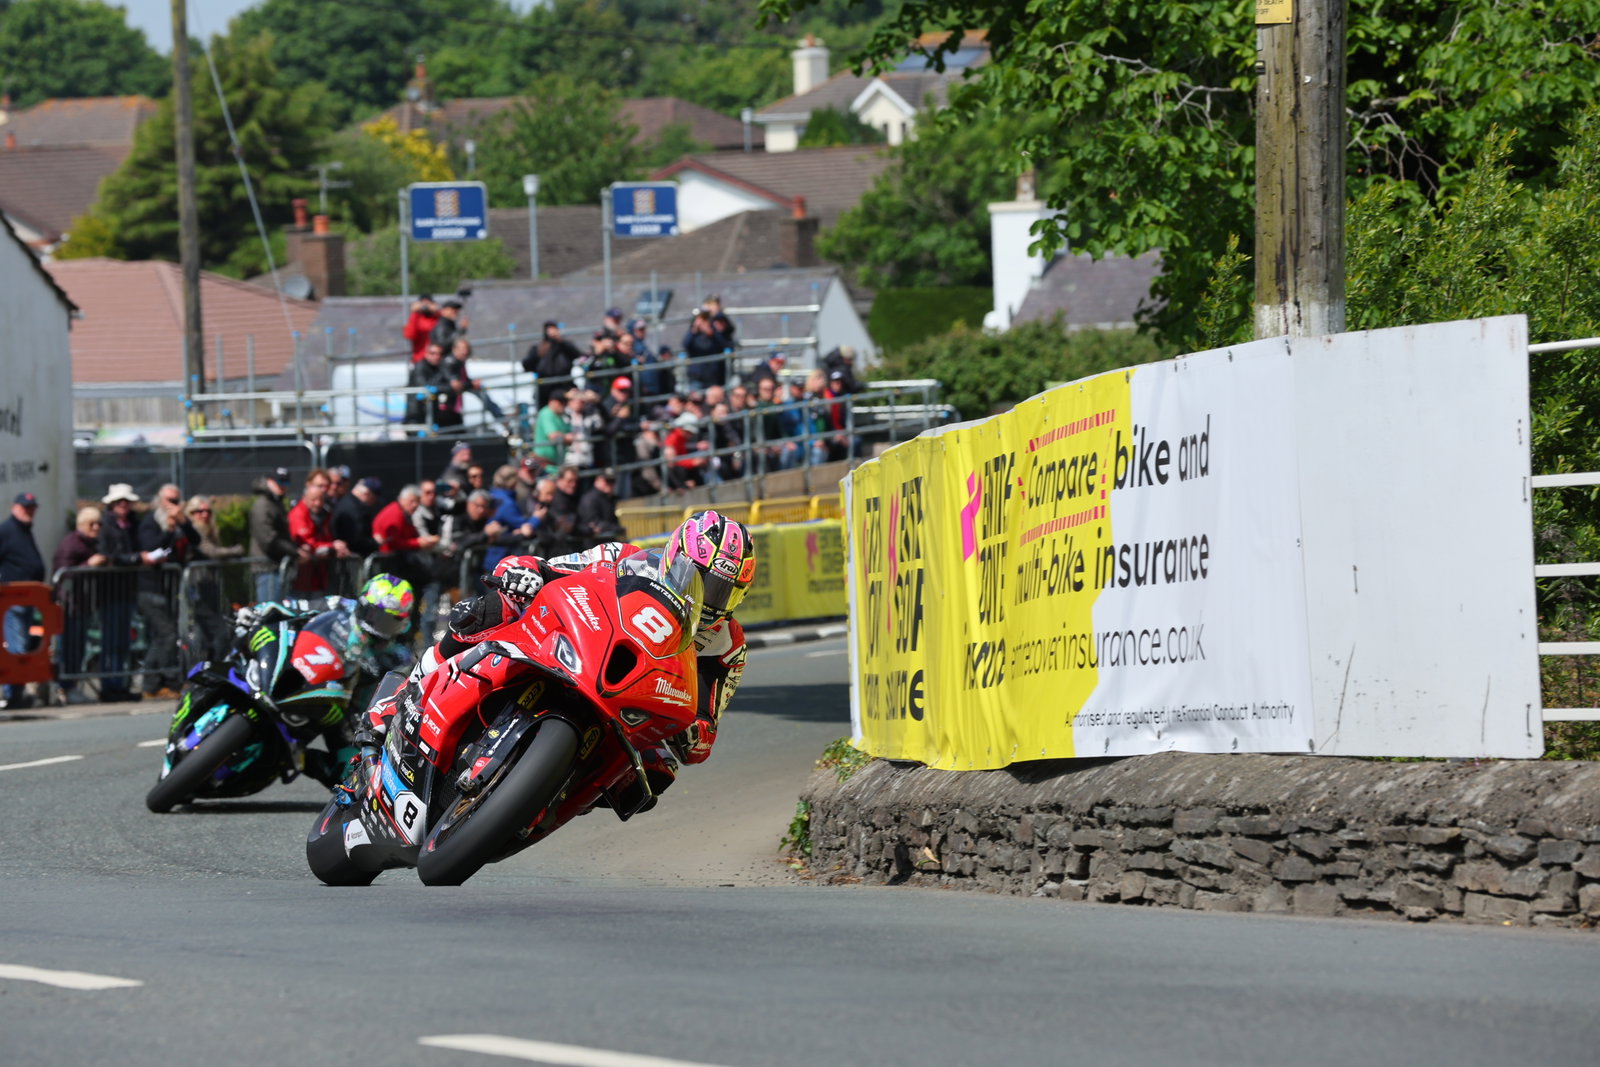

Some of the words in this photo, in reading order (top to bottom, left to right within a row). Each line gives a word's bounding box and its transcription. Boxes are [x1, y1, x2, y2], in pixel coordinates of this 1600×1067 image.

[1028, 451, 1097, 519] Compare
[1113, 424, 1170, 490] bike
[1178, 413, 1210, 482] and
[718, 560, 737, 573] Arai
[1094, 526, 1209, 590] insurance
[567, 584, 602, 631] Milwaukee
[649, 582, 682, 610] METZELER
[630, 606, 674, 644] 8
[654, 676, 692, 702] Milwaukee
[1213, 702, 1248, 721] Conduct
[1251, 700, 1294, 725] Authority
[403, 801, 418, 830] 8
